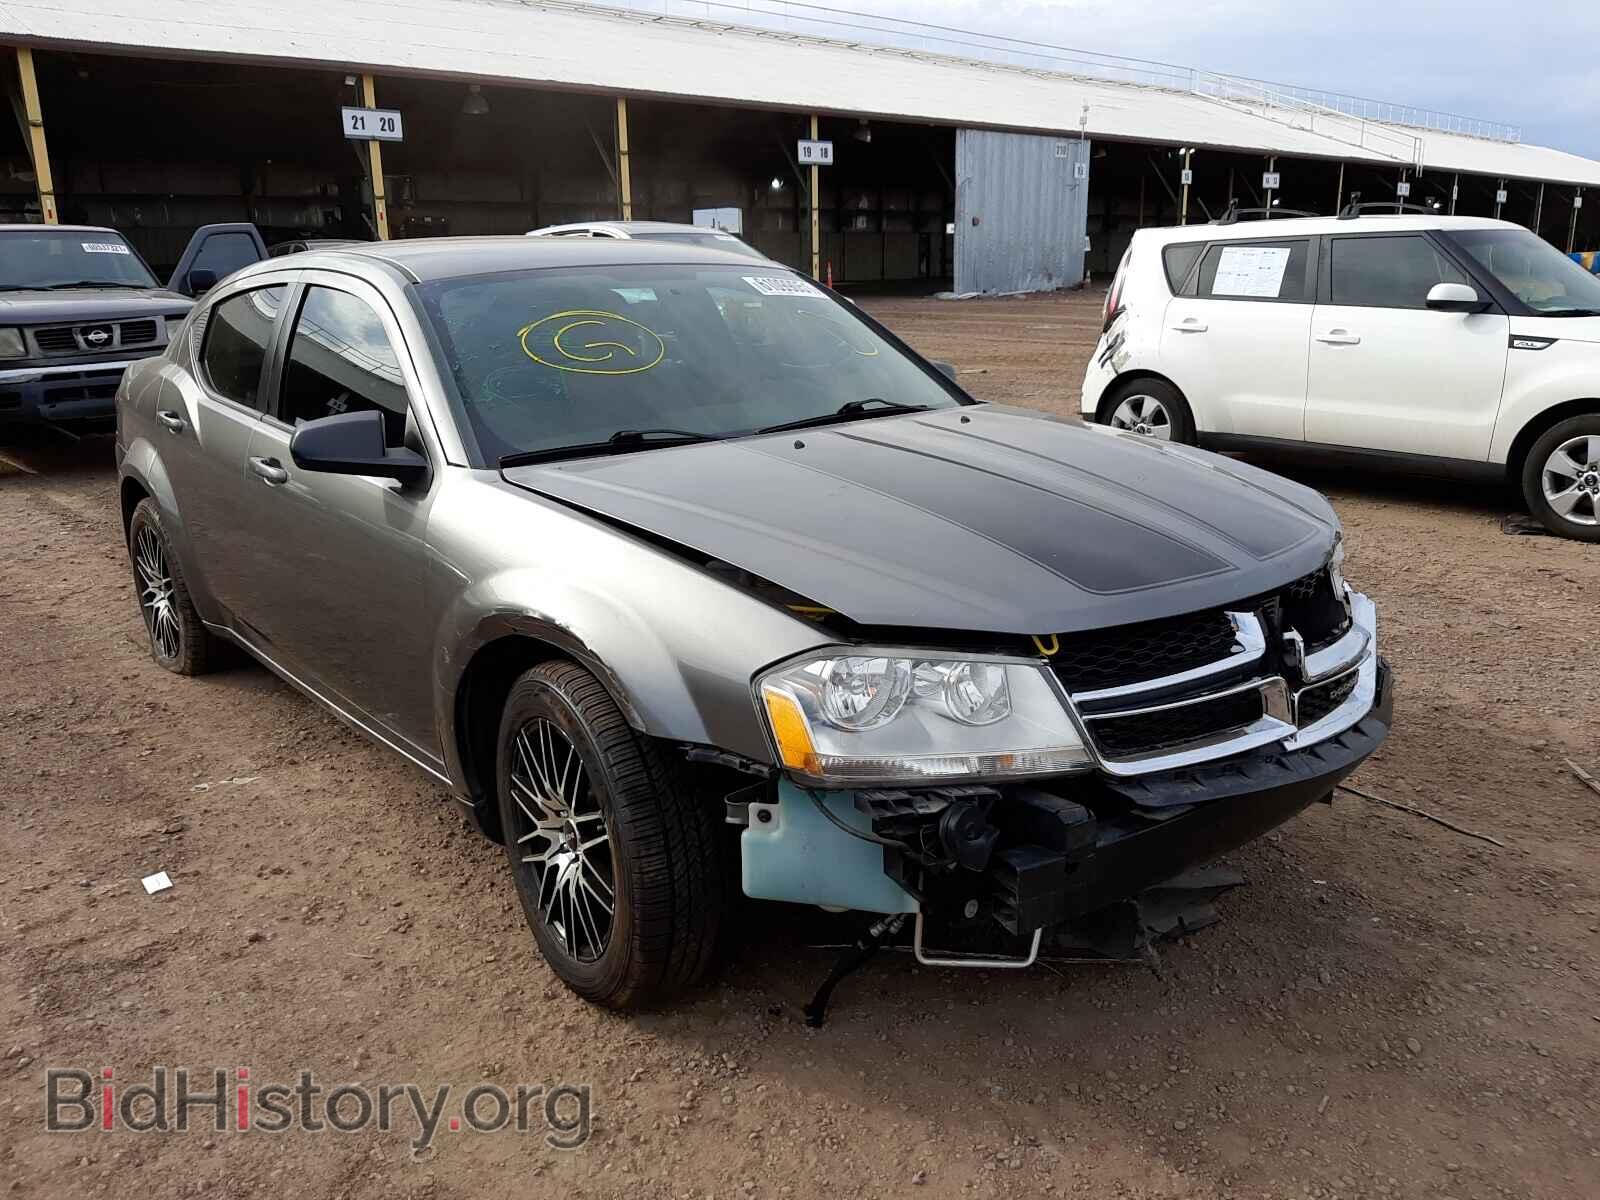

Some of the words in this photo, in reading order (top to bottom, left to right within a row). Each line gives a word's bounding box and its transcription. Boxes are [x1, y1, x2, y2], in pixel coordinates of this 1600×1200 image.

[352, 115, 366, 130] 21
[379, 117, 395, 132] 20
[803, 146, 812, 158] 19
